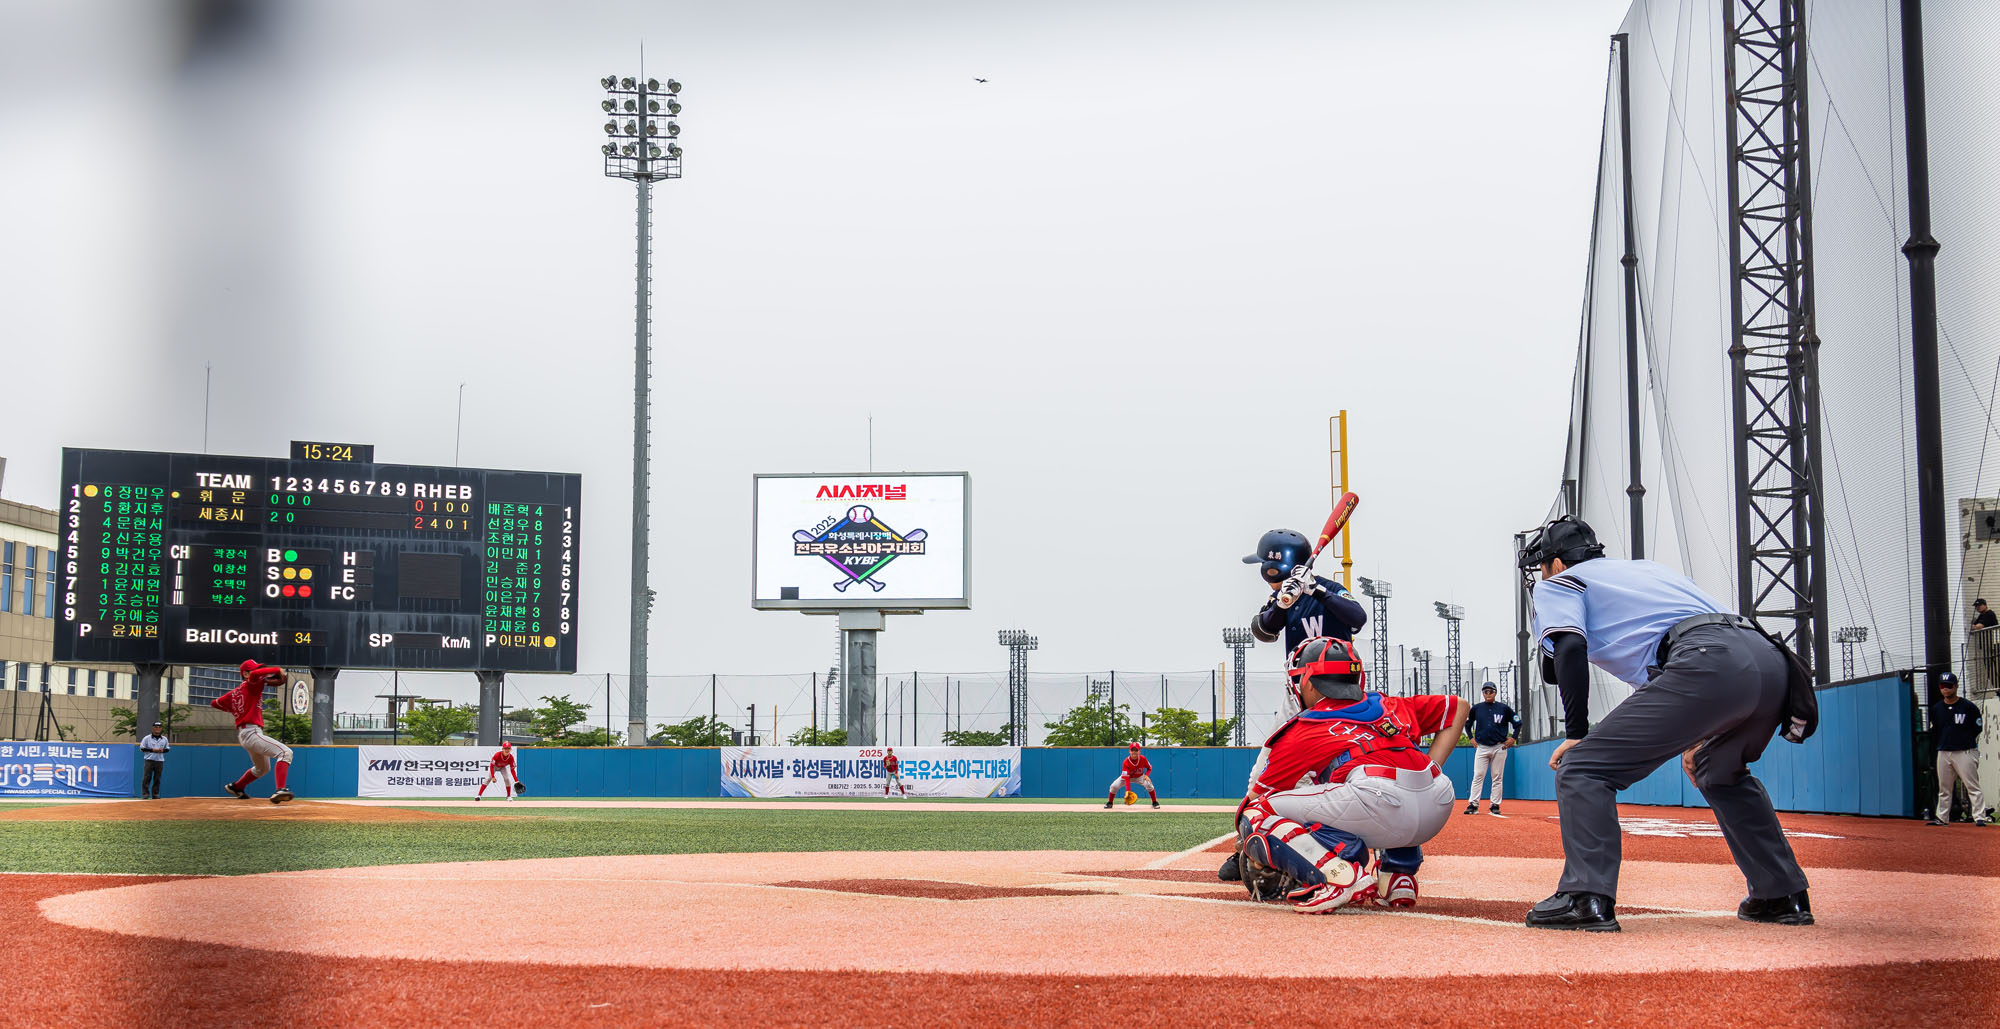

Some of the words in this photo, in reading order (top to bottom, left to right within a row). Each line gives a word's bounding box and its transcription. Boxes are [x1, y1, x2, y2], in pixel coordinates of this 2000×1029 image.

[303, 444, 353, 461] 15:24
[196, 473, 251, 489] TEAM
[272, 477, 280, 490] 1
[286, 477, 297, 491] 2
[302, 478, 313, 492] 3
[318, 478, 329, 492] 4
[334, 479, 344, 493] 5
[350, 480, 360, 494] 6
[365, 481, 376, 495] 7
[381, 482, 391, 496] 8
[396, 483, 406, 496] 9
[72, 484, 80, 497] 1
[104, 486, 113, 497] 6
[816, 484, 906, 500] 시사저널
[69, 500, 80, 512] 2
[104, 501, 112, 513] 5
[271, 494, 278, 504] 0
[287, 495, 294, 505] 0
[303, 496, 310, 506] 0
[415, 500, 424, 512] 0
[433, 502, 437, 512] 1
[446, 502, 453, 512] 0
[462, 503, 468, 513] 0
[199, 507, 243, 521] 세종시
[535, 506, 543, 516] 4
[565, 507, 571, 519] 1
[69, 515, 79, 528] 3
[103, 517, 111, 528] 4
[270, 512, 278, 522] 2
[287, 512, 294, 522] 0
[415, 517, 423, 528] 2
[430, 519, 438, 528] 4
[446, 519, 453, 529] 0
[463, 520, 466, 530] 1
[535, 520, 542, 531] 8
[563, 521, 572, 533] 2
[811, 515, 837, 535] 2025
[68, 531, 79, 543] 4
[102, 532, 110, 544] 2
[116, 532, 162, 546] 신주용
[535, 535, 542, 545] 5
[563, 536, 571, 547] 3
[68, 546, 78, 559] 5
[102, 548, 110, 558] 9
[116, 548, 161, 560] 박건우
[171, 545, 190, 559] CH
[267, 549, 281, 562] B
[536, 549, 540, 560] 1
[562, 550, 571, 562] 4
[796, 543, 924, 555] 전국유소년야구대회
[343, 552, 356, 566] H
[843, 556, 880, 565] KYBF
[67, 561, 78, 574] 6
[101, 563, 109, 574] 8
[267, 566, 280, 580] S
[534, 564, 541, 574] 2
[562, 564, 571, 576] 5
[343, 569, 355, 583] E
[66, 576, 77, 589] 7
[102, 578, 107, 590] 1
[533, 578, 540, 589] 9
[562, 579, 570, 590] 6
[266, 584, 280, 598] O
[331, 586, 355, 600] FC
[65, 592, 76, 605] 8
[99, 594, 107, 605] 3
[533, 593, 540, 603] 7
[561, 593, 570, 605] 7
[65, 608, 76, 621] 9
[99, 609, 107, 620] 7
[533, 607, 540, 618] 3
[561, 608, 569, 619] 8
[80, 624, 92, 636] P
[532, 622, 540, 632] 6
[561, 622, 569, 634] 9
[1301, 615, 1324, 638] W
[186, 629, 222, 643] Ball
[225, 629, 278, 645] Count
[295, 632, 311, 644] 34
[369, 633, 393, 647] SP
[442, 636, 471, 649] Km/h
[486, 634, 496, 647] P
[500, 634, 540, 647] 이민재
[1493, 714, 1503, 724] W
[1954, 713, 1966, 724] W
[48, 746, 82, 759] 빛나는
[86, 748, 109, 759] 도시
[859, 750, 883, 758] 2025
[368, 760, 402, 771] KMI
[404, 760, 491, 772] 한국의학연구
[387, 777, 414, 786] 건강한
[416, 777, 443, 786] 내일을
